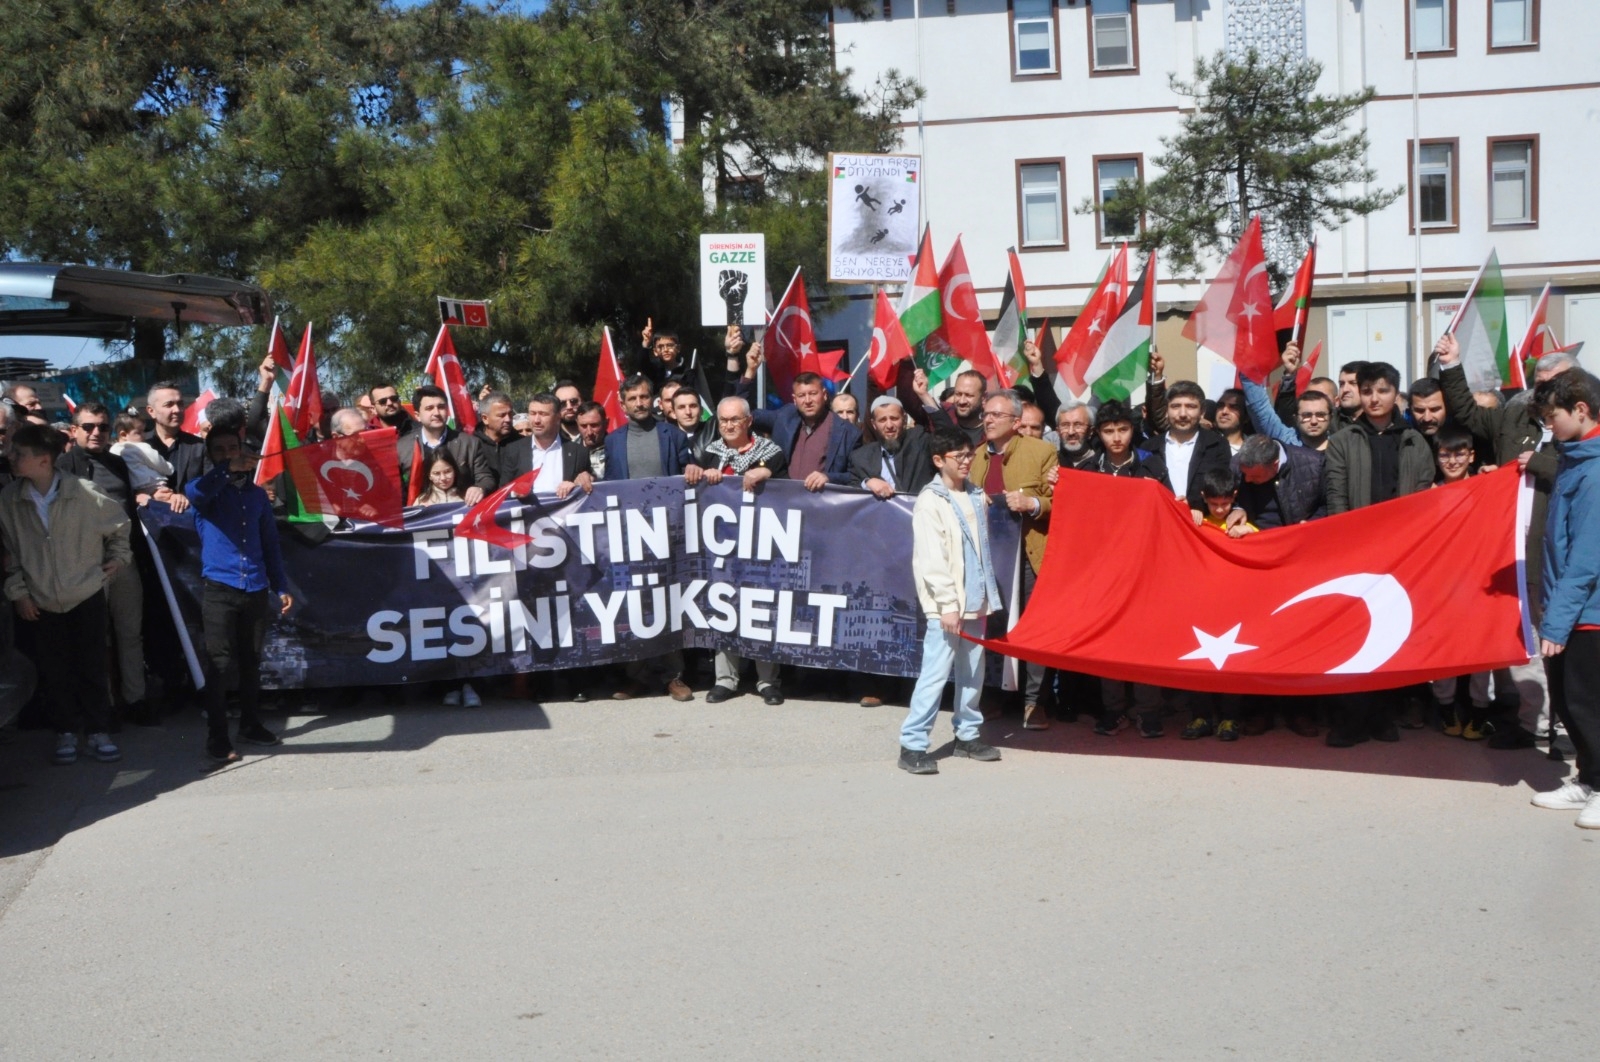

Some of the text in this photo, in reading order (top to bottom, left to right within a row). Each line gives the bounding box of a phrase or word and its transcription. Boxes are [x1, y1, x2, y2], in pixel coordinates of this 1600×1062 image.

[888, 158, 917, 170] ARŞA
[709, 252, 756, 264] GAZZE
[834, 256, 904, 266] SEN NEREYE
[412, 489, 802, 580] FİLİSTİN İÇİN
[366, 573, 847, 663] SESİNİ YÜKSELT
